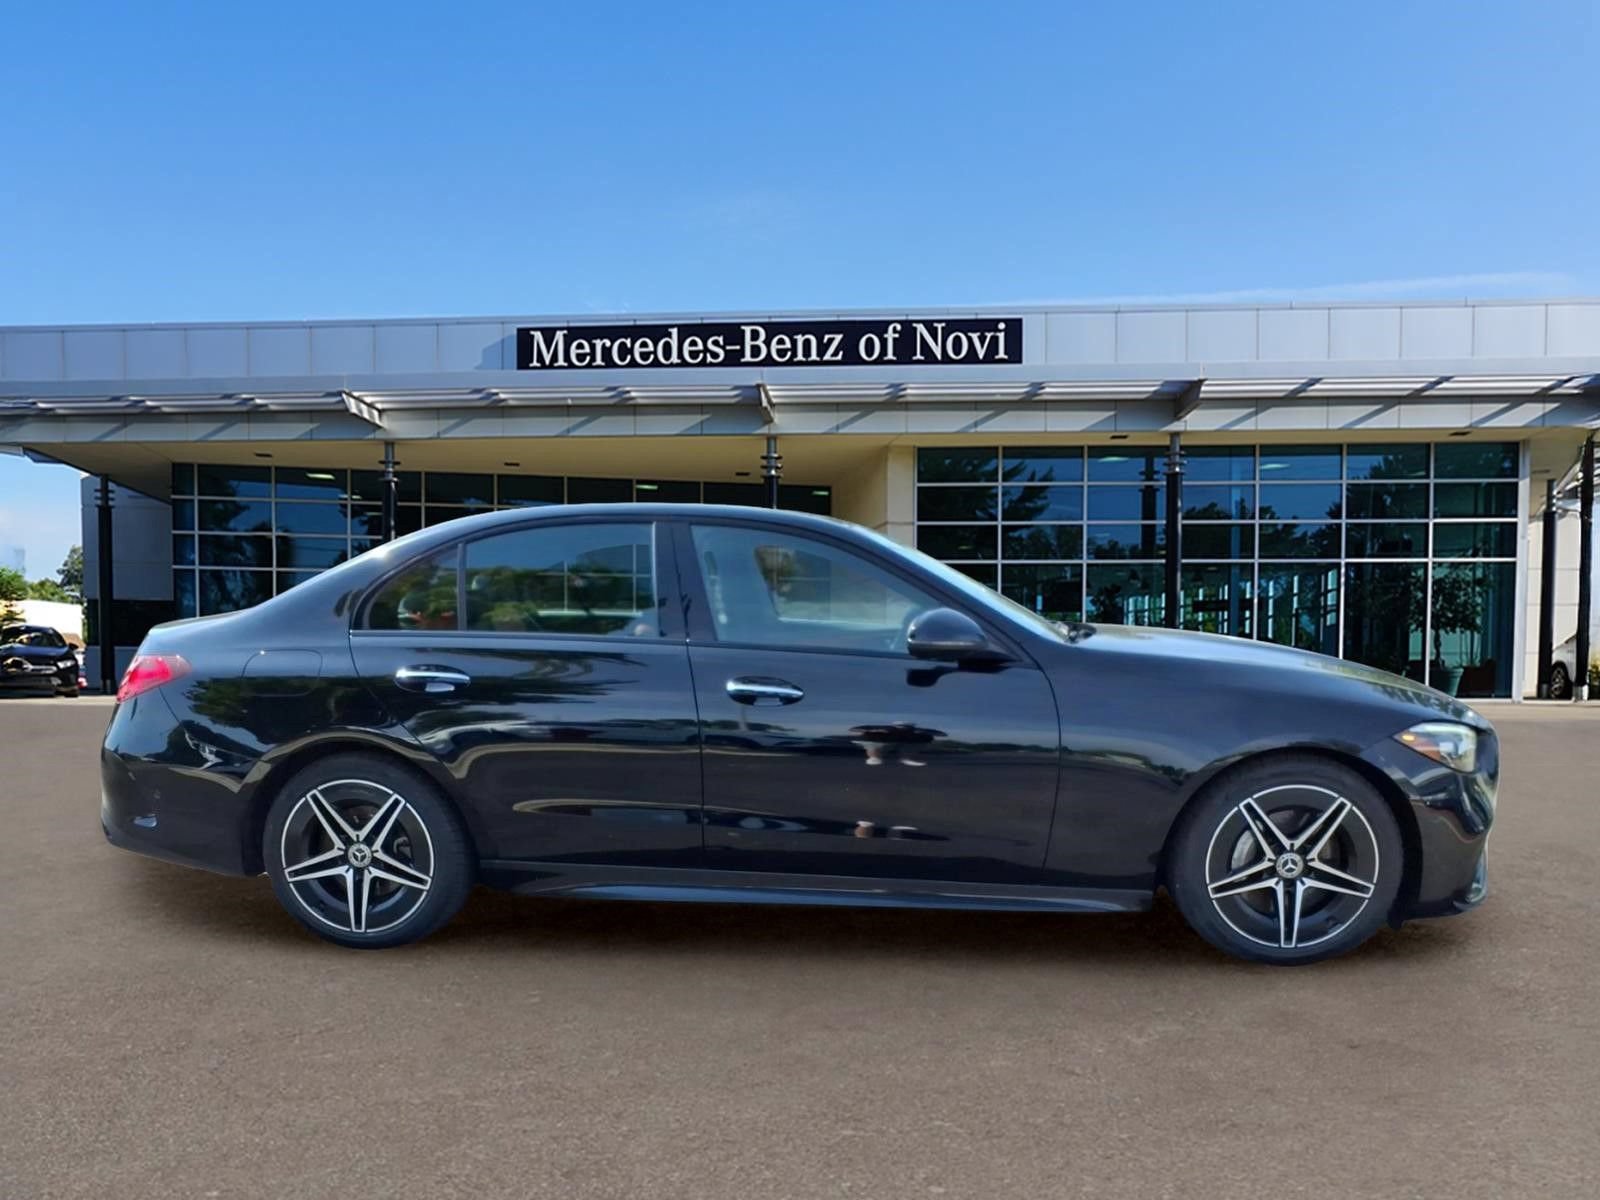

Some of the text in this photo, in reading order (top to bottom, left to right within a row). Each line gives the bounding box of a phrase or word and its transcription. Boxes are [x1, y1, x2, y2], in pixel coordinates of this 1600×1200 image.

[529, 322, 1008, 367] Mercedes-Benz of Novi
